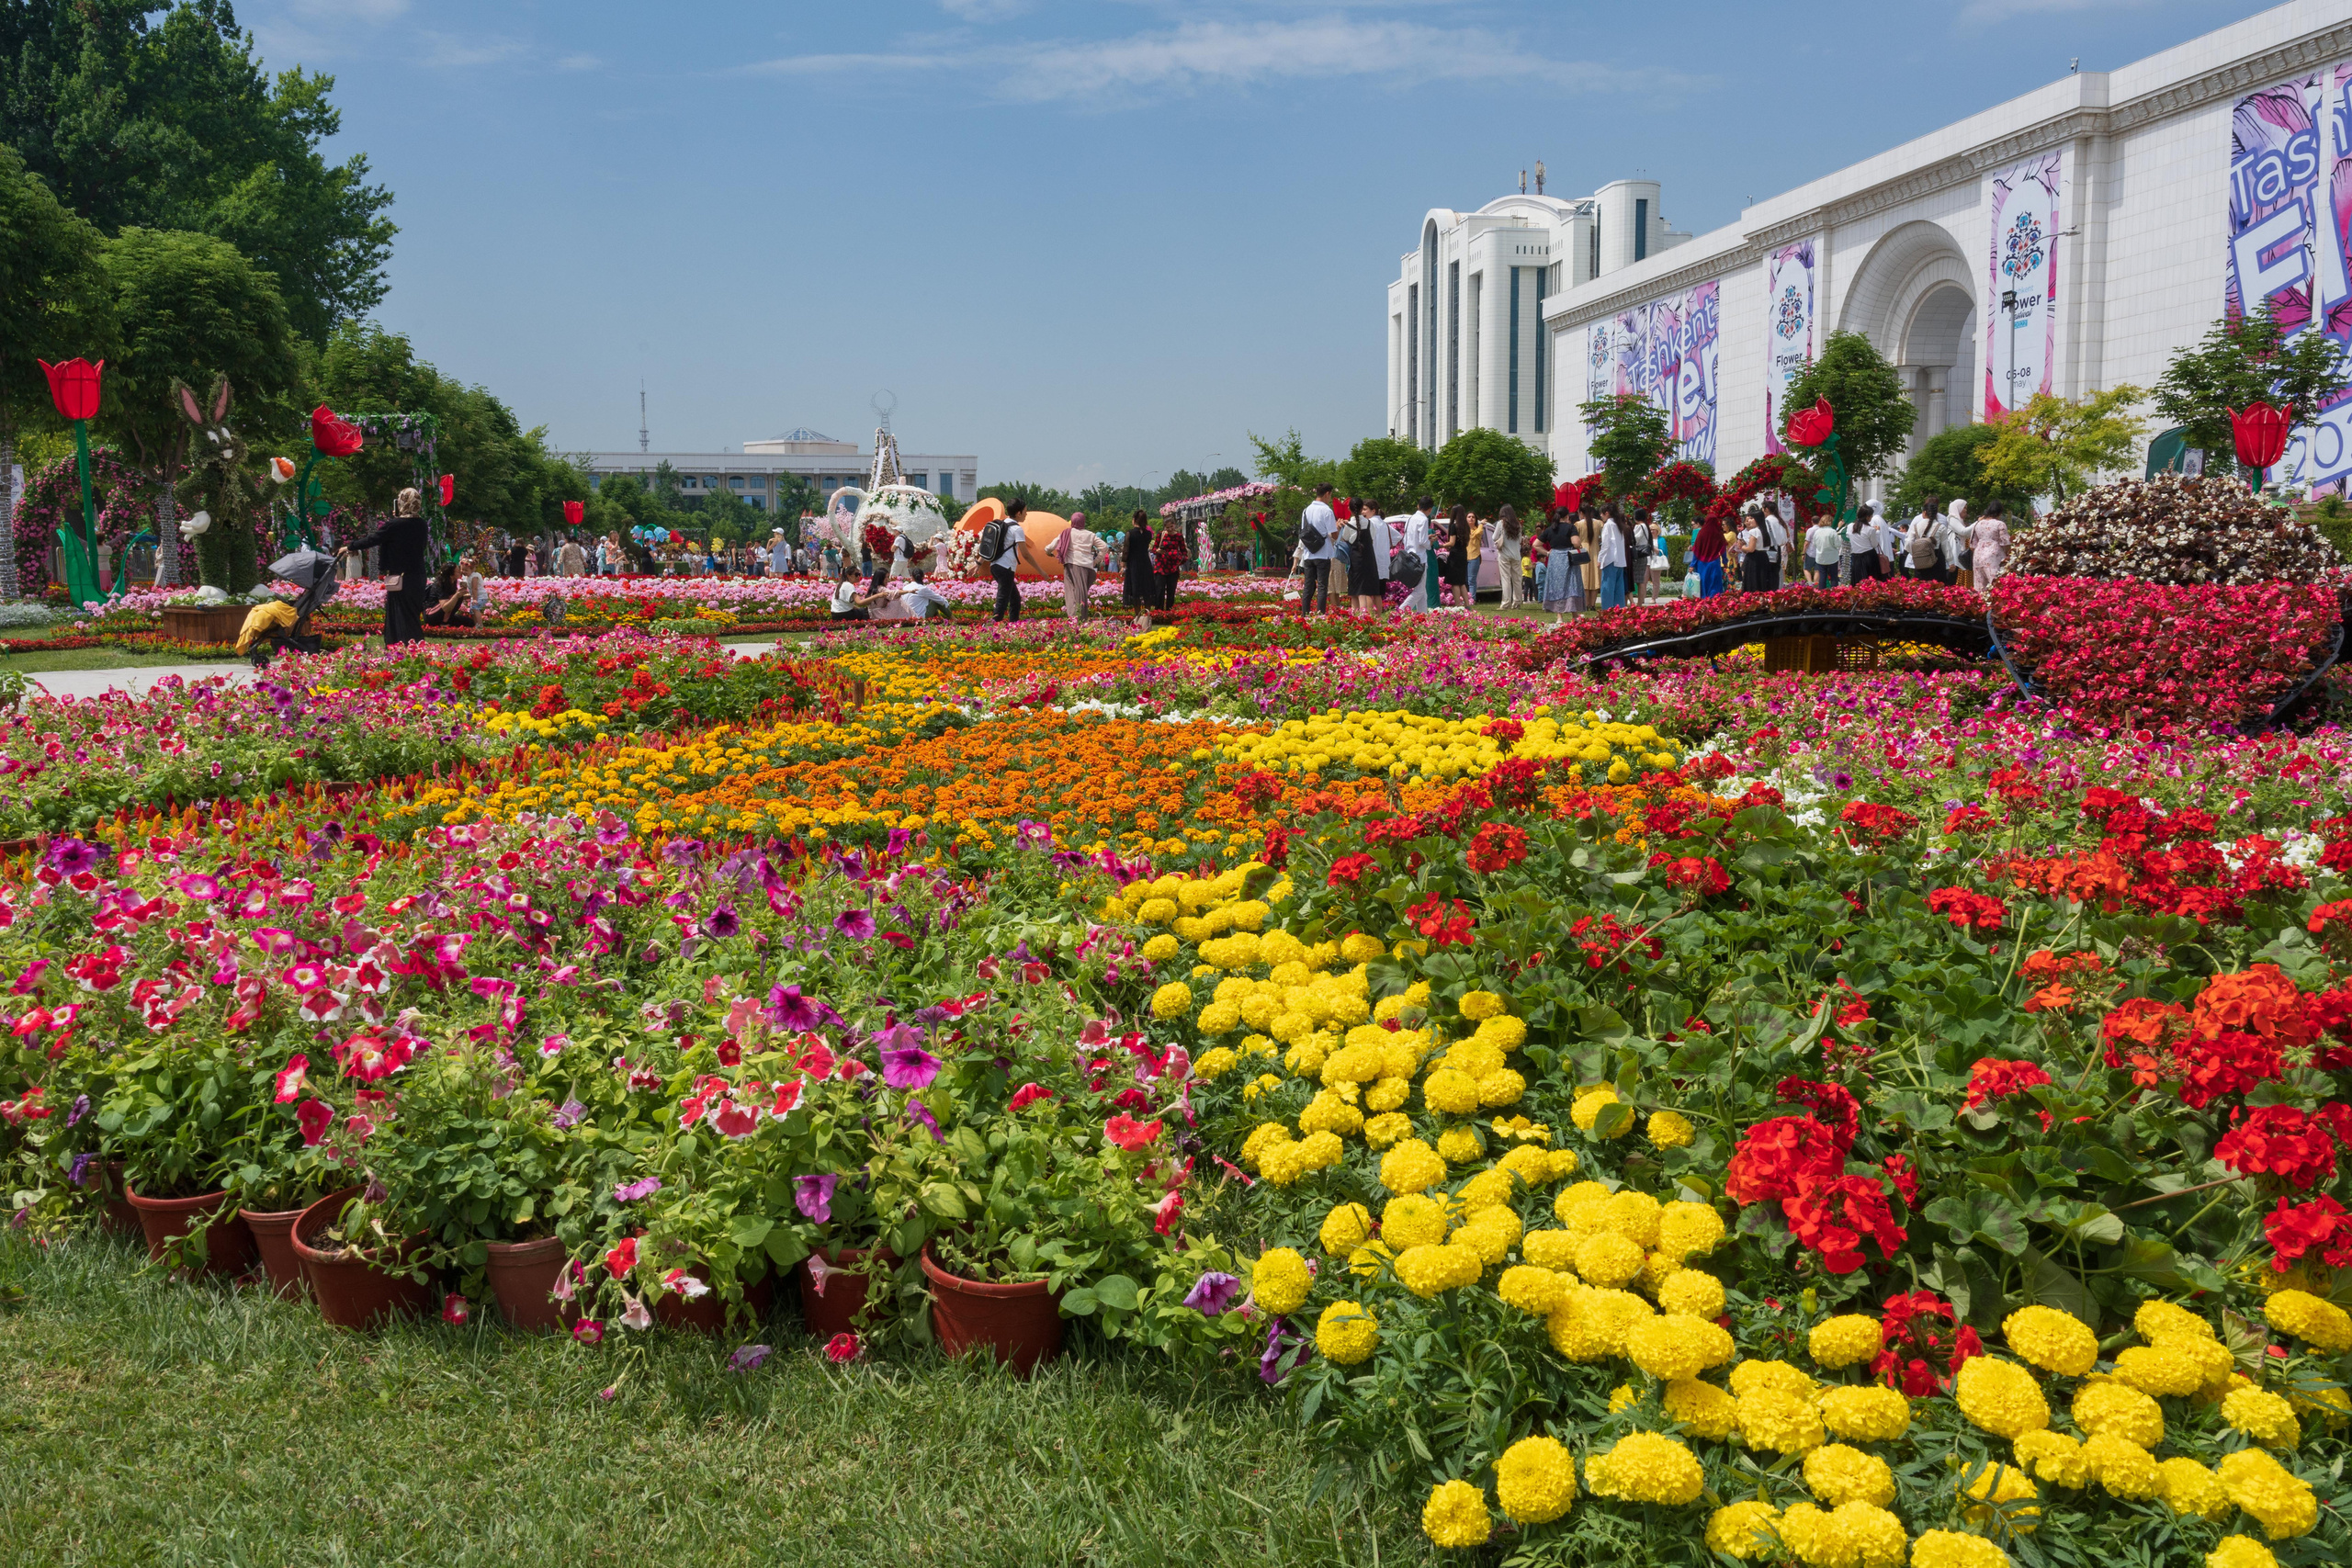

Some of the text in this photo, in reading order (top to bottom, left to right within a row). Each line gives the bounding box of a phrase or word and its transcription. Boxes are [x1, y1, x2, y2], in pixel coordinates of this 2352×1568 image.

[2230, 79, 2352, 216] Tash
[2001, 293, 2041, 313] Fower
[1626, 297, 1716, 397] Tashkent
[1776, 353, 1803, 367] Flower
